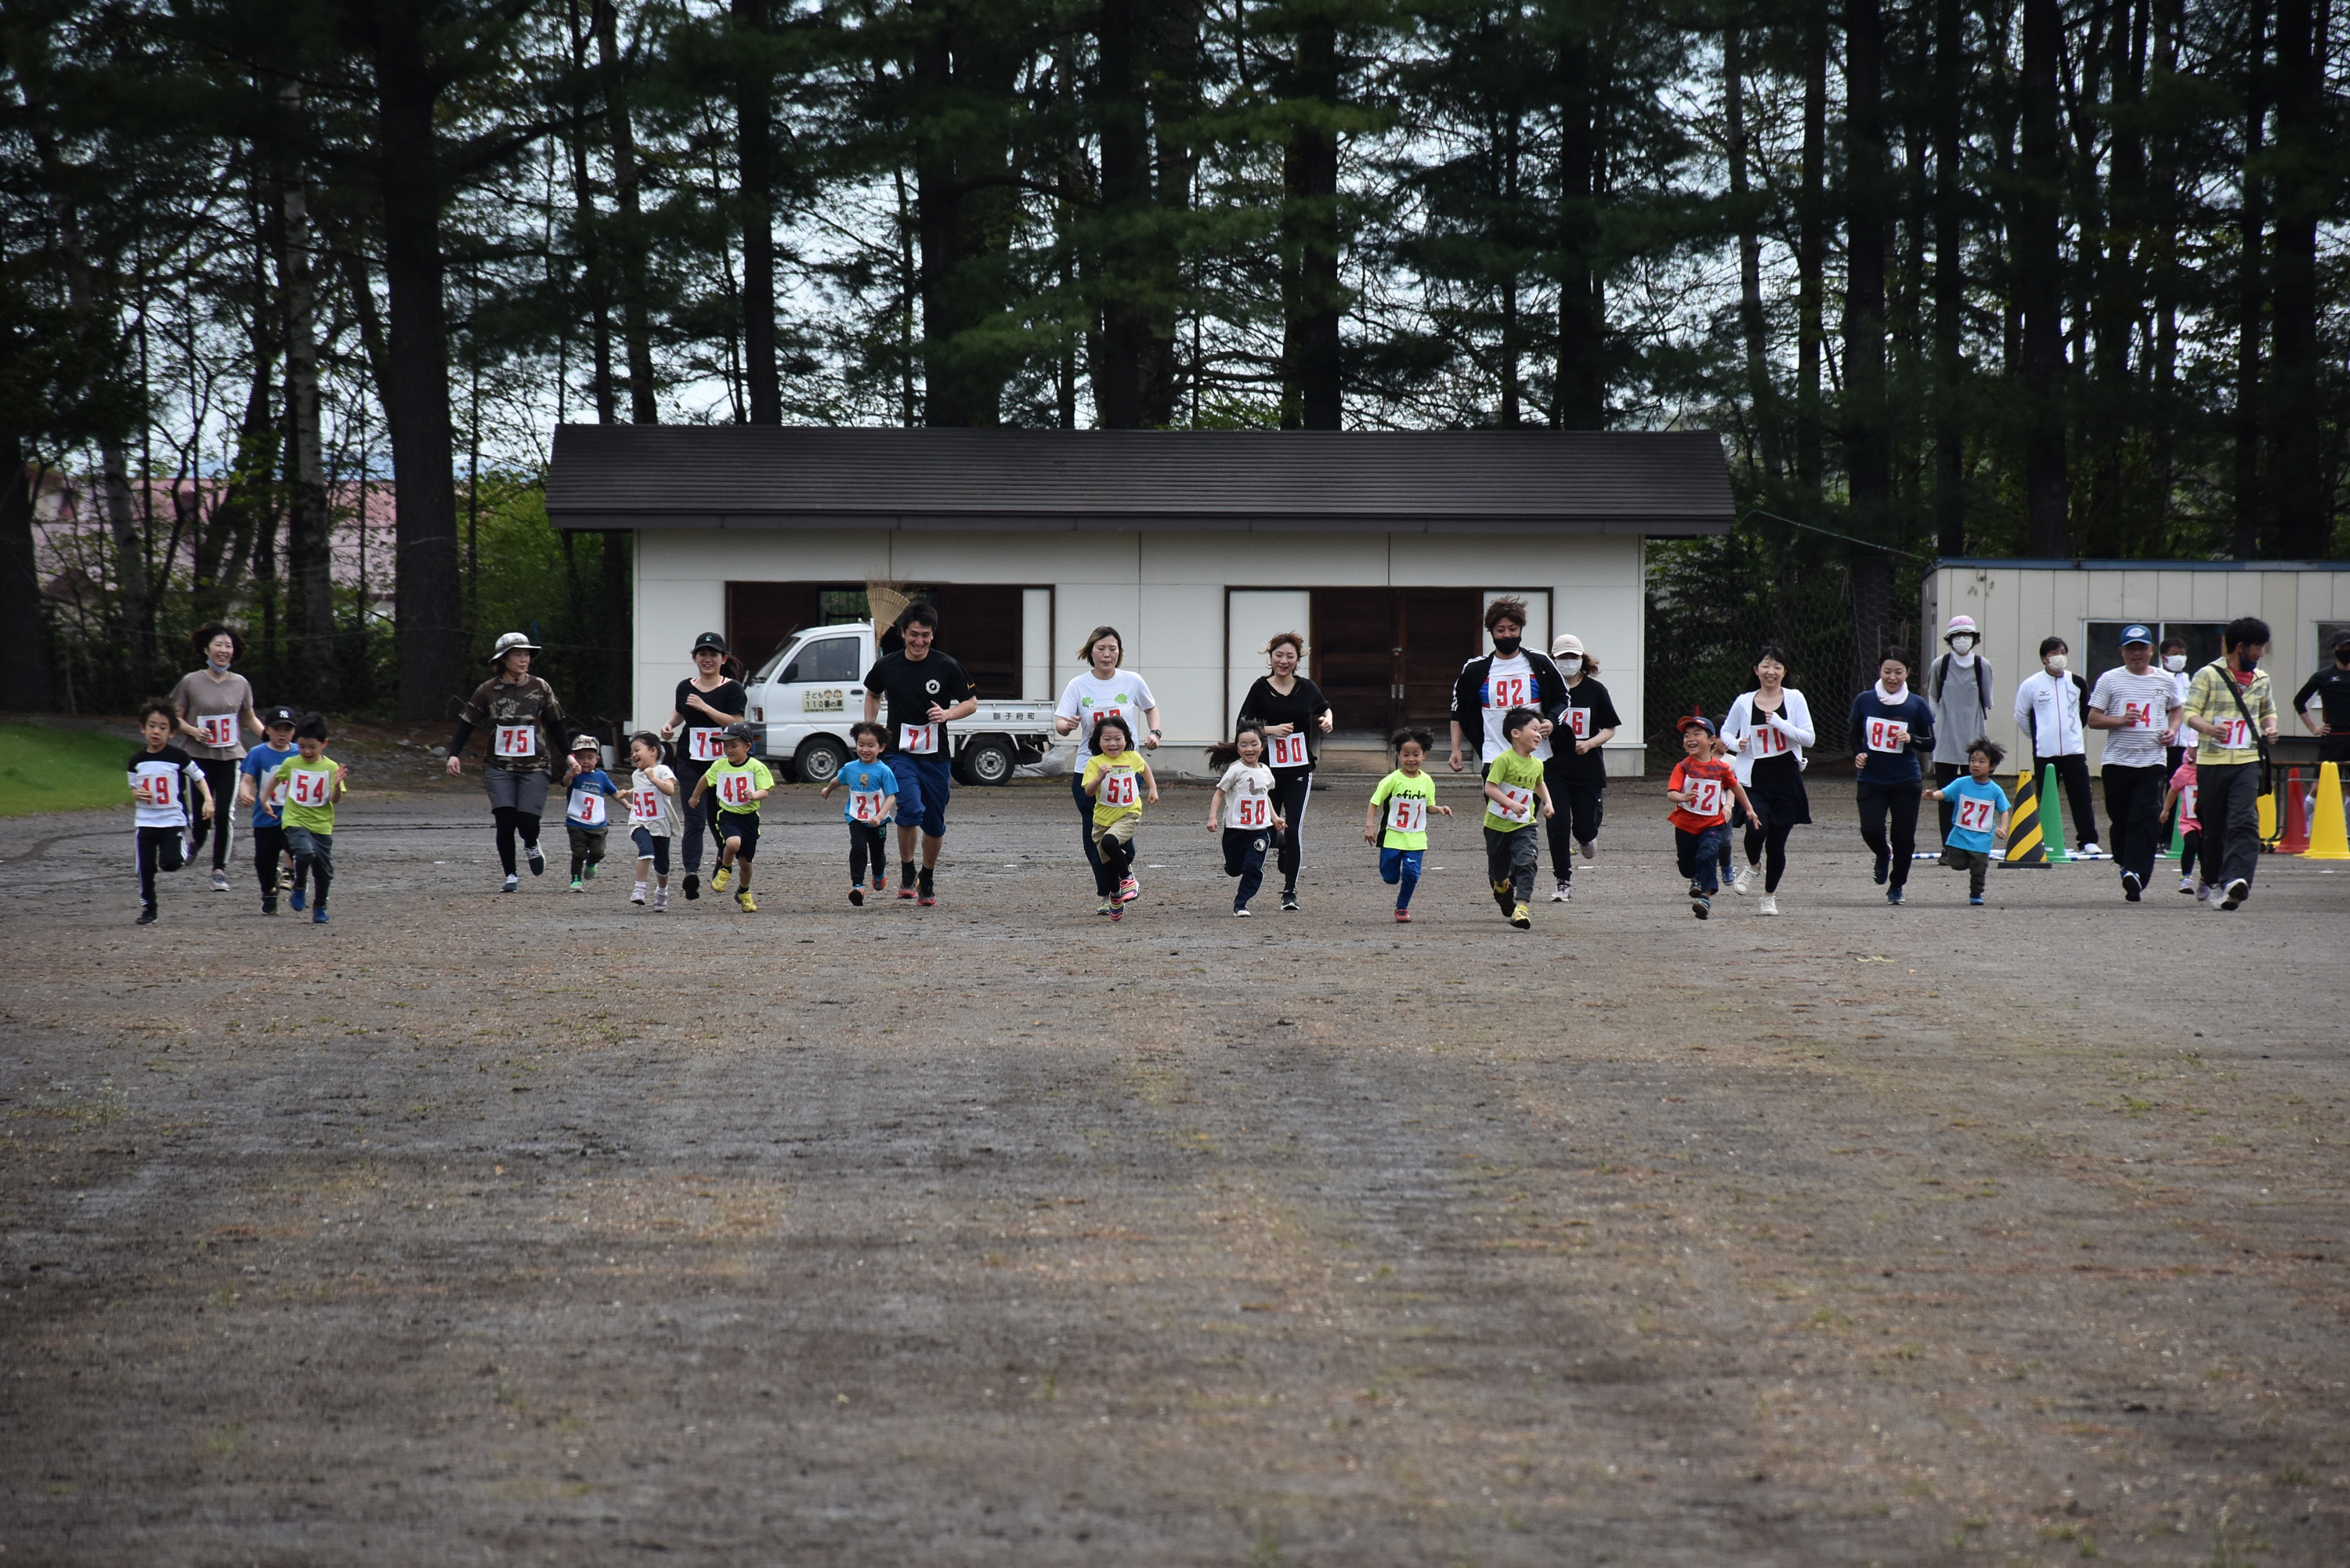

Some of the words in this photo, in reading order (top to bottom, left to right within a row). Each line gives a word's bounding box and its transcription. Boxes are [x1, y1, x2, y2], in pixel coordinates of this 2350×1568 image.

[1496, 679, 1524, 706] 92
[1564, 711, 1583, 735] 6
[1871, 721, 1900, 750] 85
[503, 729, 528, 753] 75
[908, 725, 931, 751] 71
[1275, 737, 1302, 764] 80
[1757, 728, 1787, 753] 70
[296, 775, 324, 802] 54
[723, 776, 749, 803] 48
[1107, 776, 1133, 804] 53
[1690, 782, 1716, 811] 42
[580, 797, 595, 821] 3
[634, 792, 657, 817] 55
[856, 795, 880, 819] 21
[1240, 799, 1265, 825] 50
[1396, 802, 1421, 829] 51
[1961, 800, 1990, 828] 27
